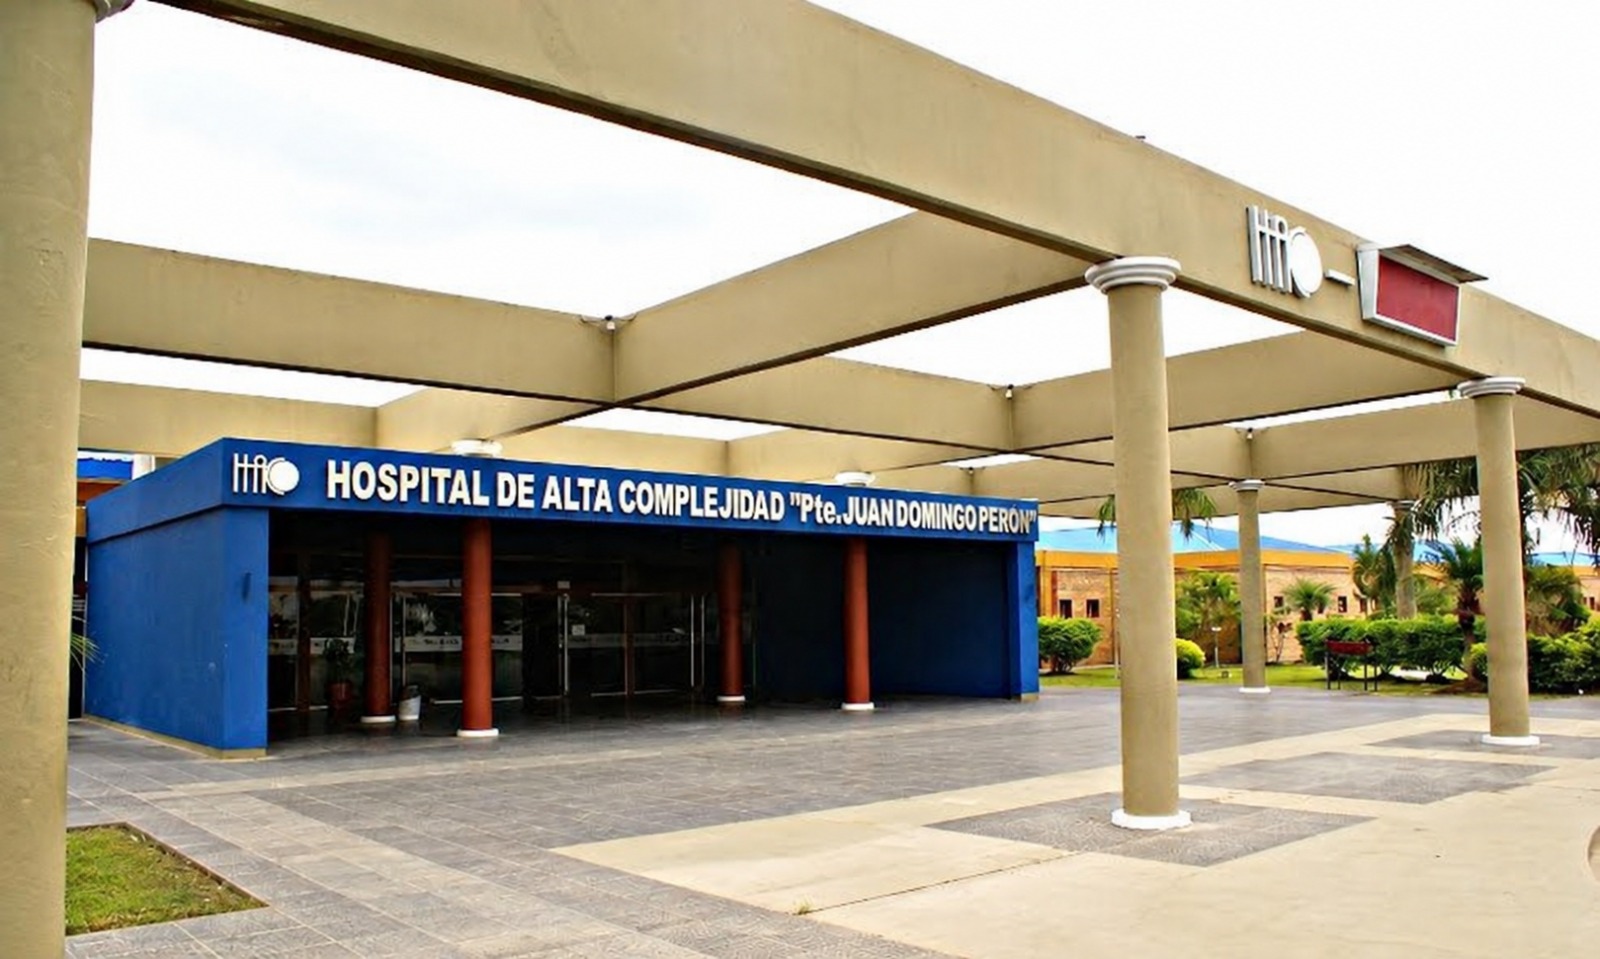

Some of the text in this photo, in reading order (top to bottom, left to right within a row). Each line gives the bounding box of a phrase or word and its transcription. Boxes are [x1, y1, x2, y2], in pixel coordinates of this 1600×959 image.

[327, 459, 490, 506] HOSPITAL
[497, 472, 535, 509] DE
[541, 475, 613, 513] ALTA
[618, 479, 785, 521] COMPLEJIDAD
[895, 499, 977, 531] DOMINGO
